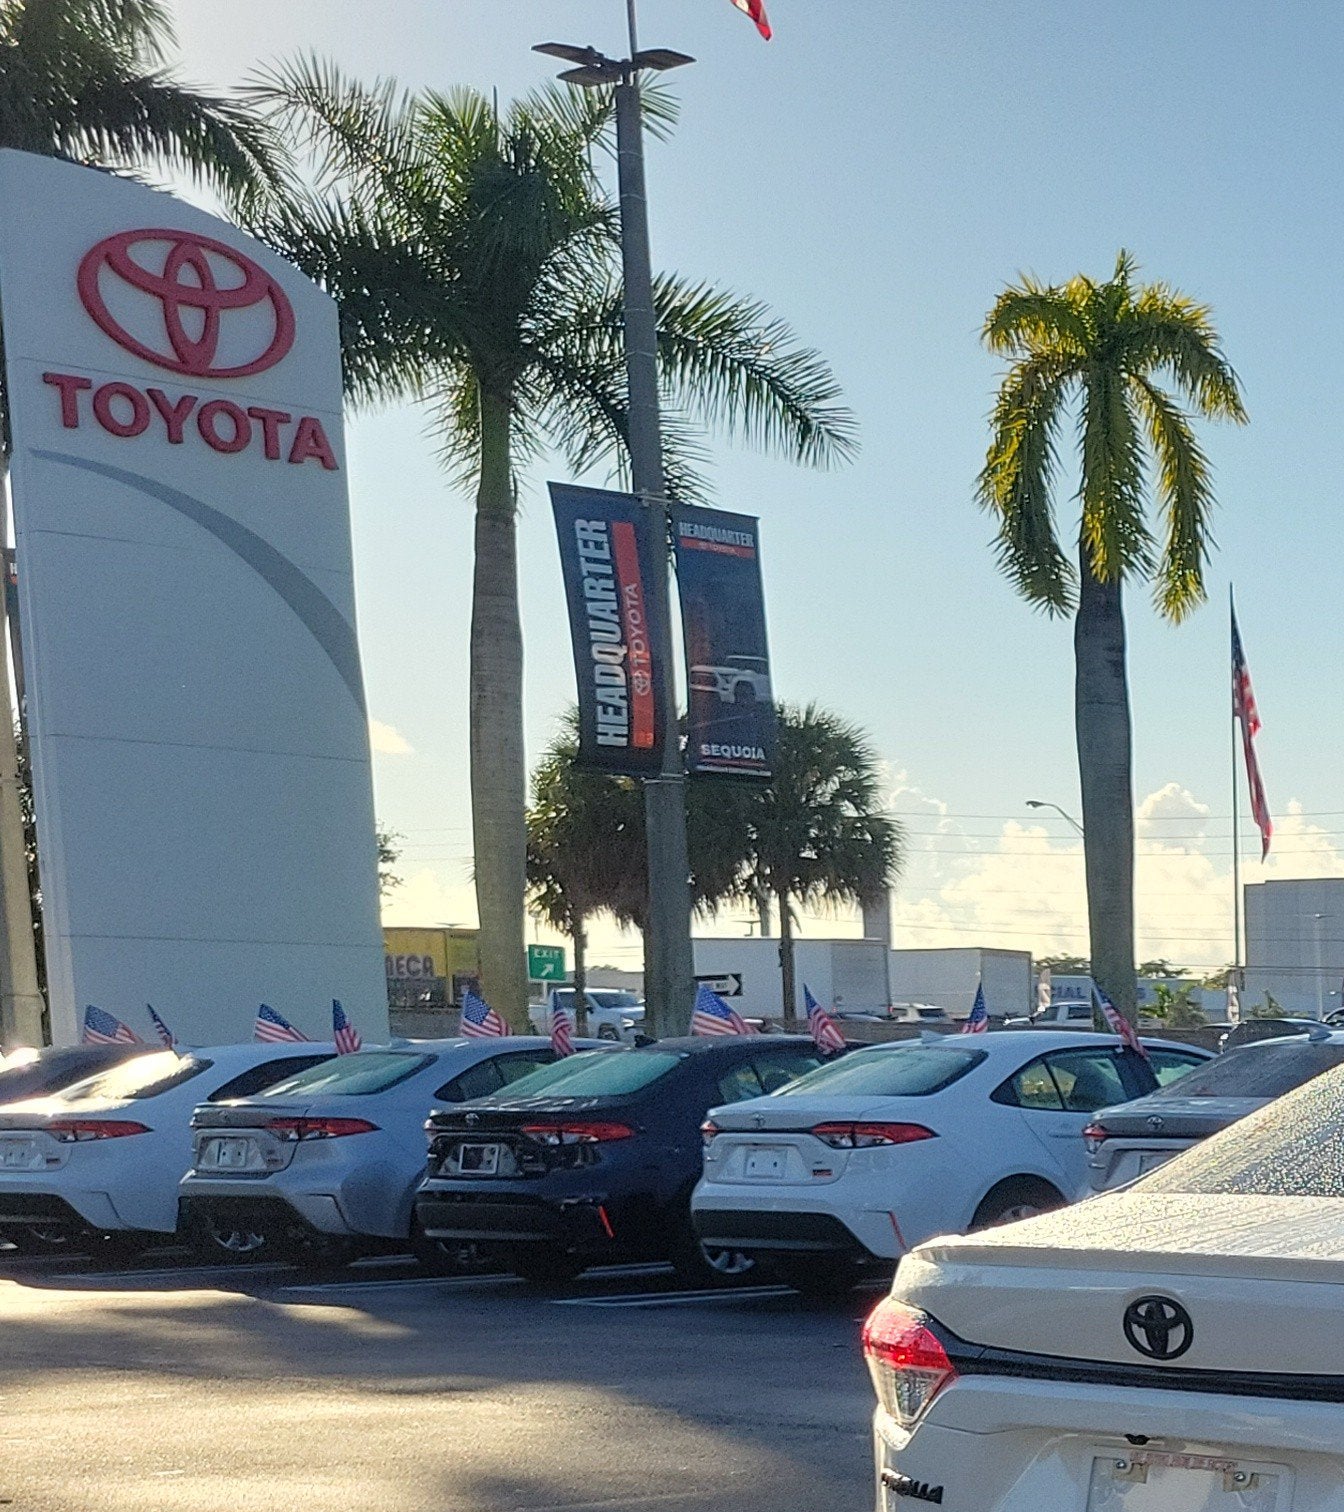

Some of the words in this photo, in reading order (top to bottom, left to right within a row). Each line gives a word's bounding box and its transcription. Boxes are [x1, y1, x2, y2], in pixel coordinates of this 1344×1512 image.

[42, 372, 340, 470] TOYOTA
[574, 518, 629, 747] HEADQUARTER
[624, 582, 652, 668] TOYOTA
[701, 744, 766, 760] SEQUOIA
[534, 948, 560, 959] EXIT
